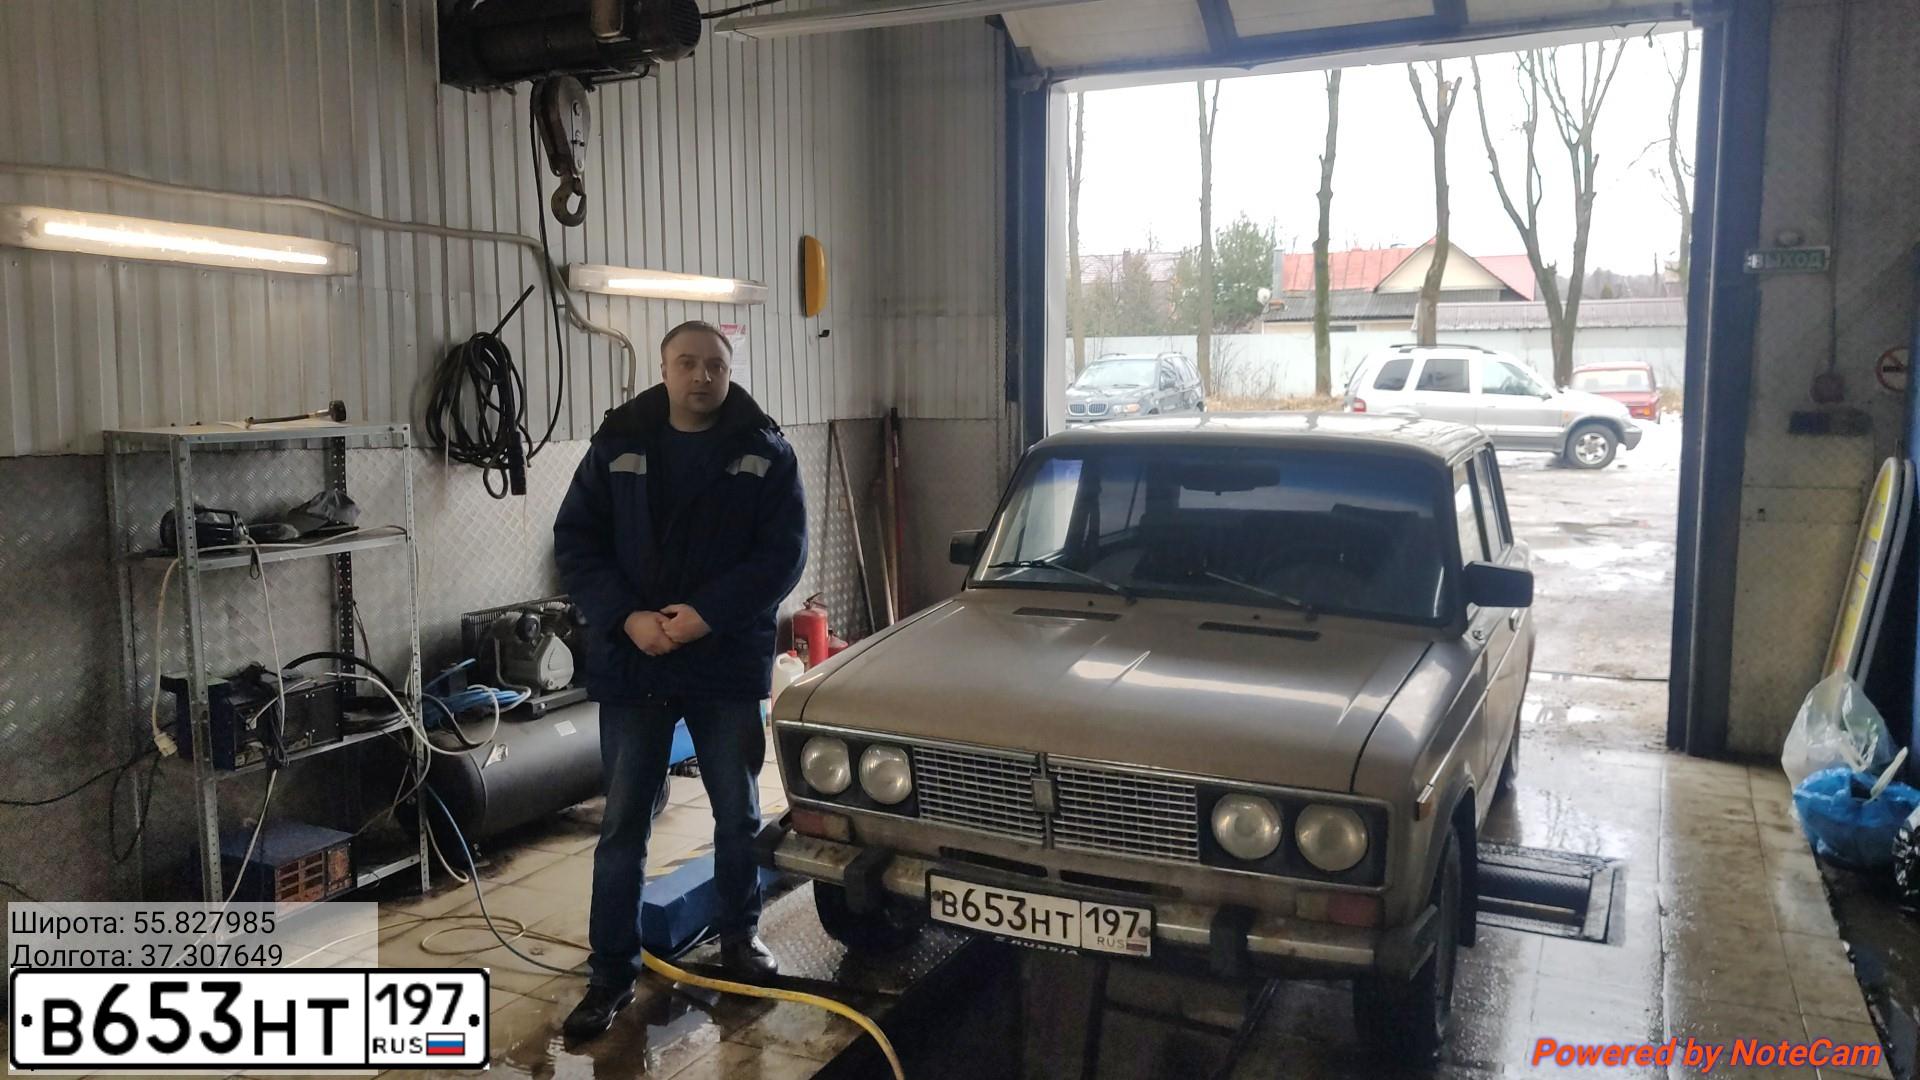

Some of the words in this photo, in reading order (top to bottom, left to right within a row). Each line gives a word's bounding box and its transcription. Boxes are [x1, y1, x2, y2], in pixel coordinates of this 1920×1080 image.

[940, 888, 1074, 939] В653НТ
[1085, 907, 1140, 938] 197
[1096, 935, 1126, 949] RUS
